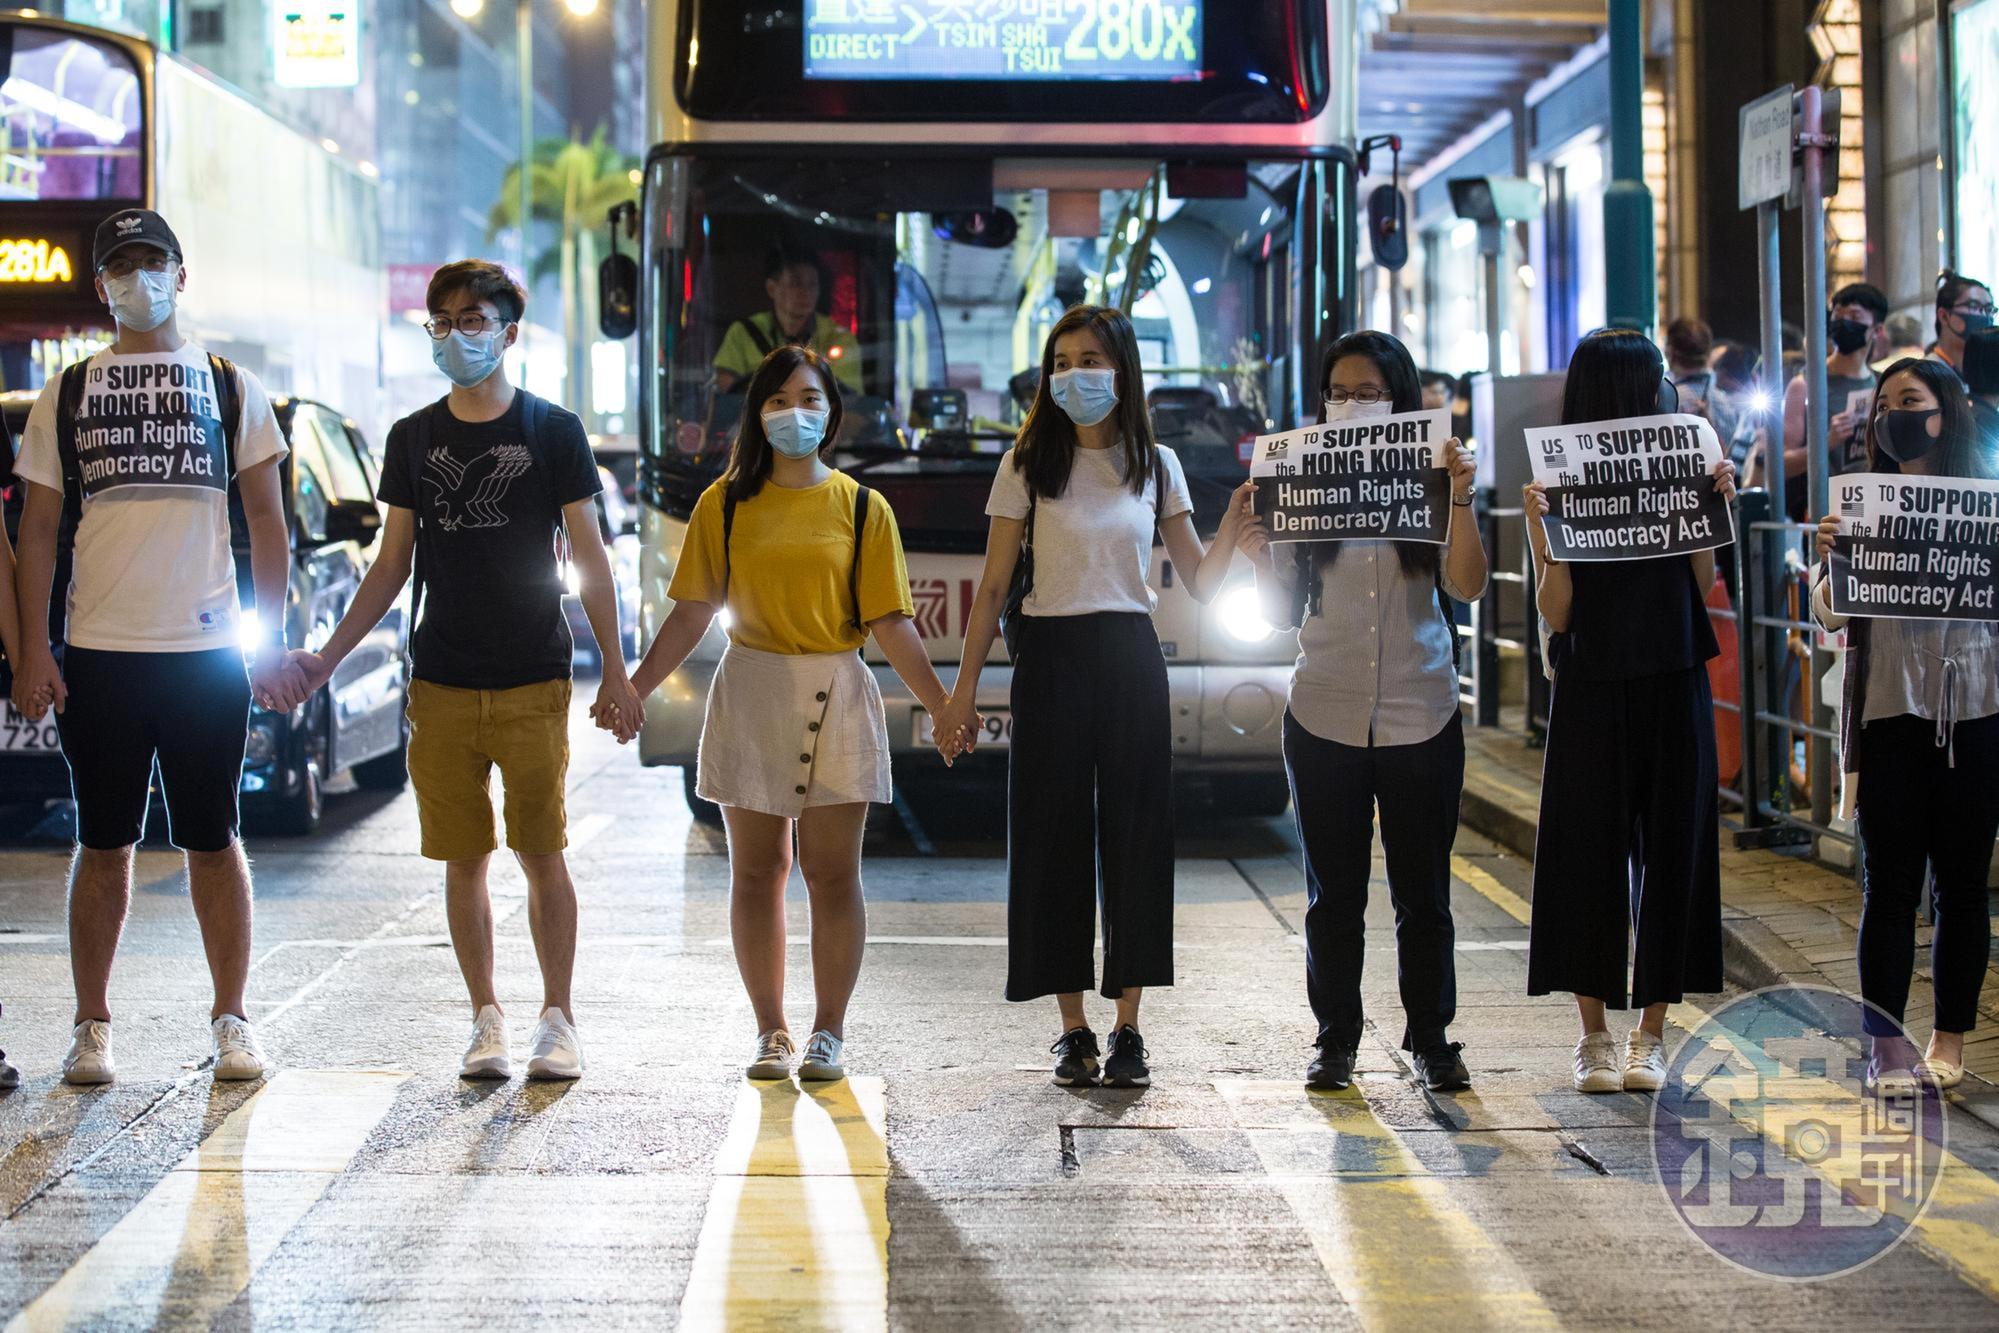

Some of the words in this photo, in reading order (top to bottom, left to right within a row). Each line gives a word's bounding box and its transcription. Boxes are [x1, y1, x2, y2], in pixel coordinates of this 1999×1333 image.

[935, 22, 998, 48] TSIM
[1002, 22, 1048, 48] SHA
[1063, 0, 1197, 61] 280X
[809, 33, 900, 60] DIRECT
[1002, 46, 1062, 73] TSUI
[116, 227, 143, 238] adidas
[0, 239, 72, 282] 281A
[89, 367, 103, 384] TO
[107, 363, 208, 393] SUPPORT
[88, 393, 150, 418] HONG
[155, 391, 212, 418] KONG
[75, 426, 135, 453] Human
[142, 419, 206, 450] Rights
[1268, 438, 1289, 452] US
[1303, 431, 1319, 445] TO
[1323, 419, 1432, 449] SUPPORT
[1541, 438, 1565, 455] US
[1576, 434, 1593, 450] TO
[1596, 424, 1701, 457] SUPPORT
[79, 454, 174, 484] Democracy
[180, 449, 213, 477] Act
[1275, 462, 1296, 477] the
[1302, 449, 1364, 476] HONG
[1371, 446, 1432, 472] KONG
[1559, 471, 1579, 487] the
[1583, 457, 1644, 485] HONG
[1647, 453, 1706, 481] KONG
[1278, 483, 1351, 507] Human
[1359, 477, 1425, 507] Rights
[1562, 492, 1631, 519] Human
[1638, 486, 1700, 519] Rights
[1842, 486, 1864, 502] US
[1879, 485, 1895, 502] TO
[1273, 510, 1391, 534] Democracy
[1397, 504, 1432, 529] Act
[1561, 521, 1671, 550] Democracy
[1678, 515, 1712, 541] Act
[1851, 521, 1872, 538] the
[1877, 515, 1939, 541] HONG
[1851, 543, 1921, 573] Human
[1926, 547, 1992, 582] Rights
[1847, 575, 1956, 613] Democracy
[1959, 581, 1994, 609] Act
